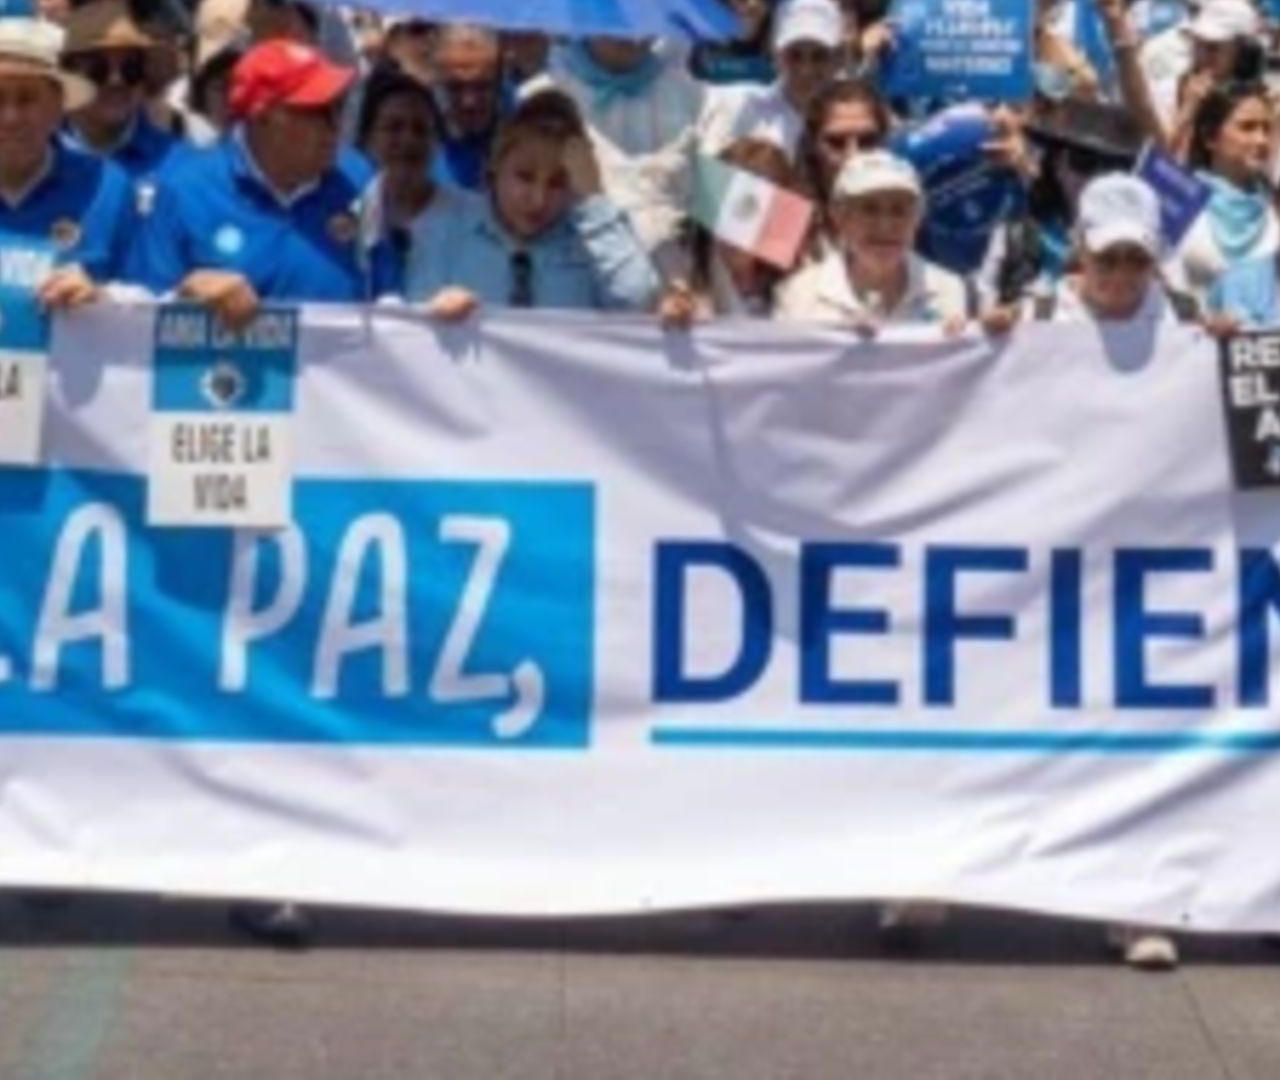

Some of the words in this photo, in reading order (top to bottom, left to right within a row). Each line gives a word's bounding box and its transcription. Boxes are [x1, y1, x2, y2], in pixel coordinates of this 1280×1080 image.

[1230, 373, 1280, 407] EL
[171, 422, 235, 464] ELIGE
[243, 424, 271, 464] LA
[194, 474, 247, 513] VIDA
[217, 510, 546, 740] PAZ,
